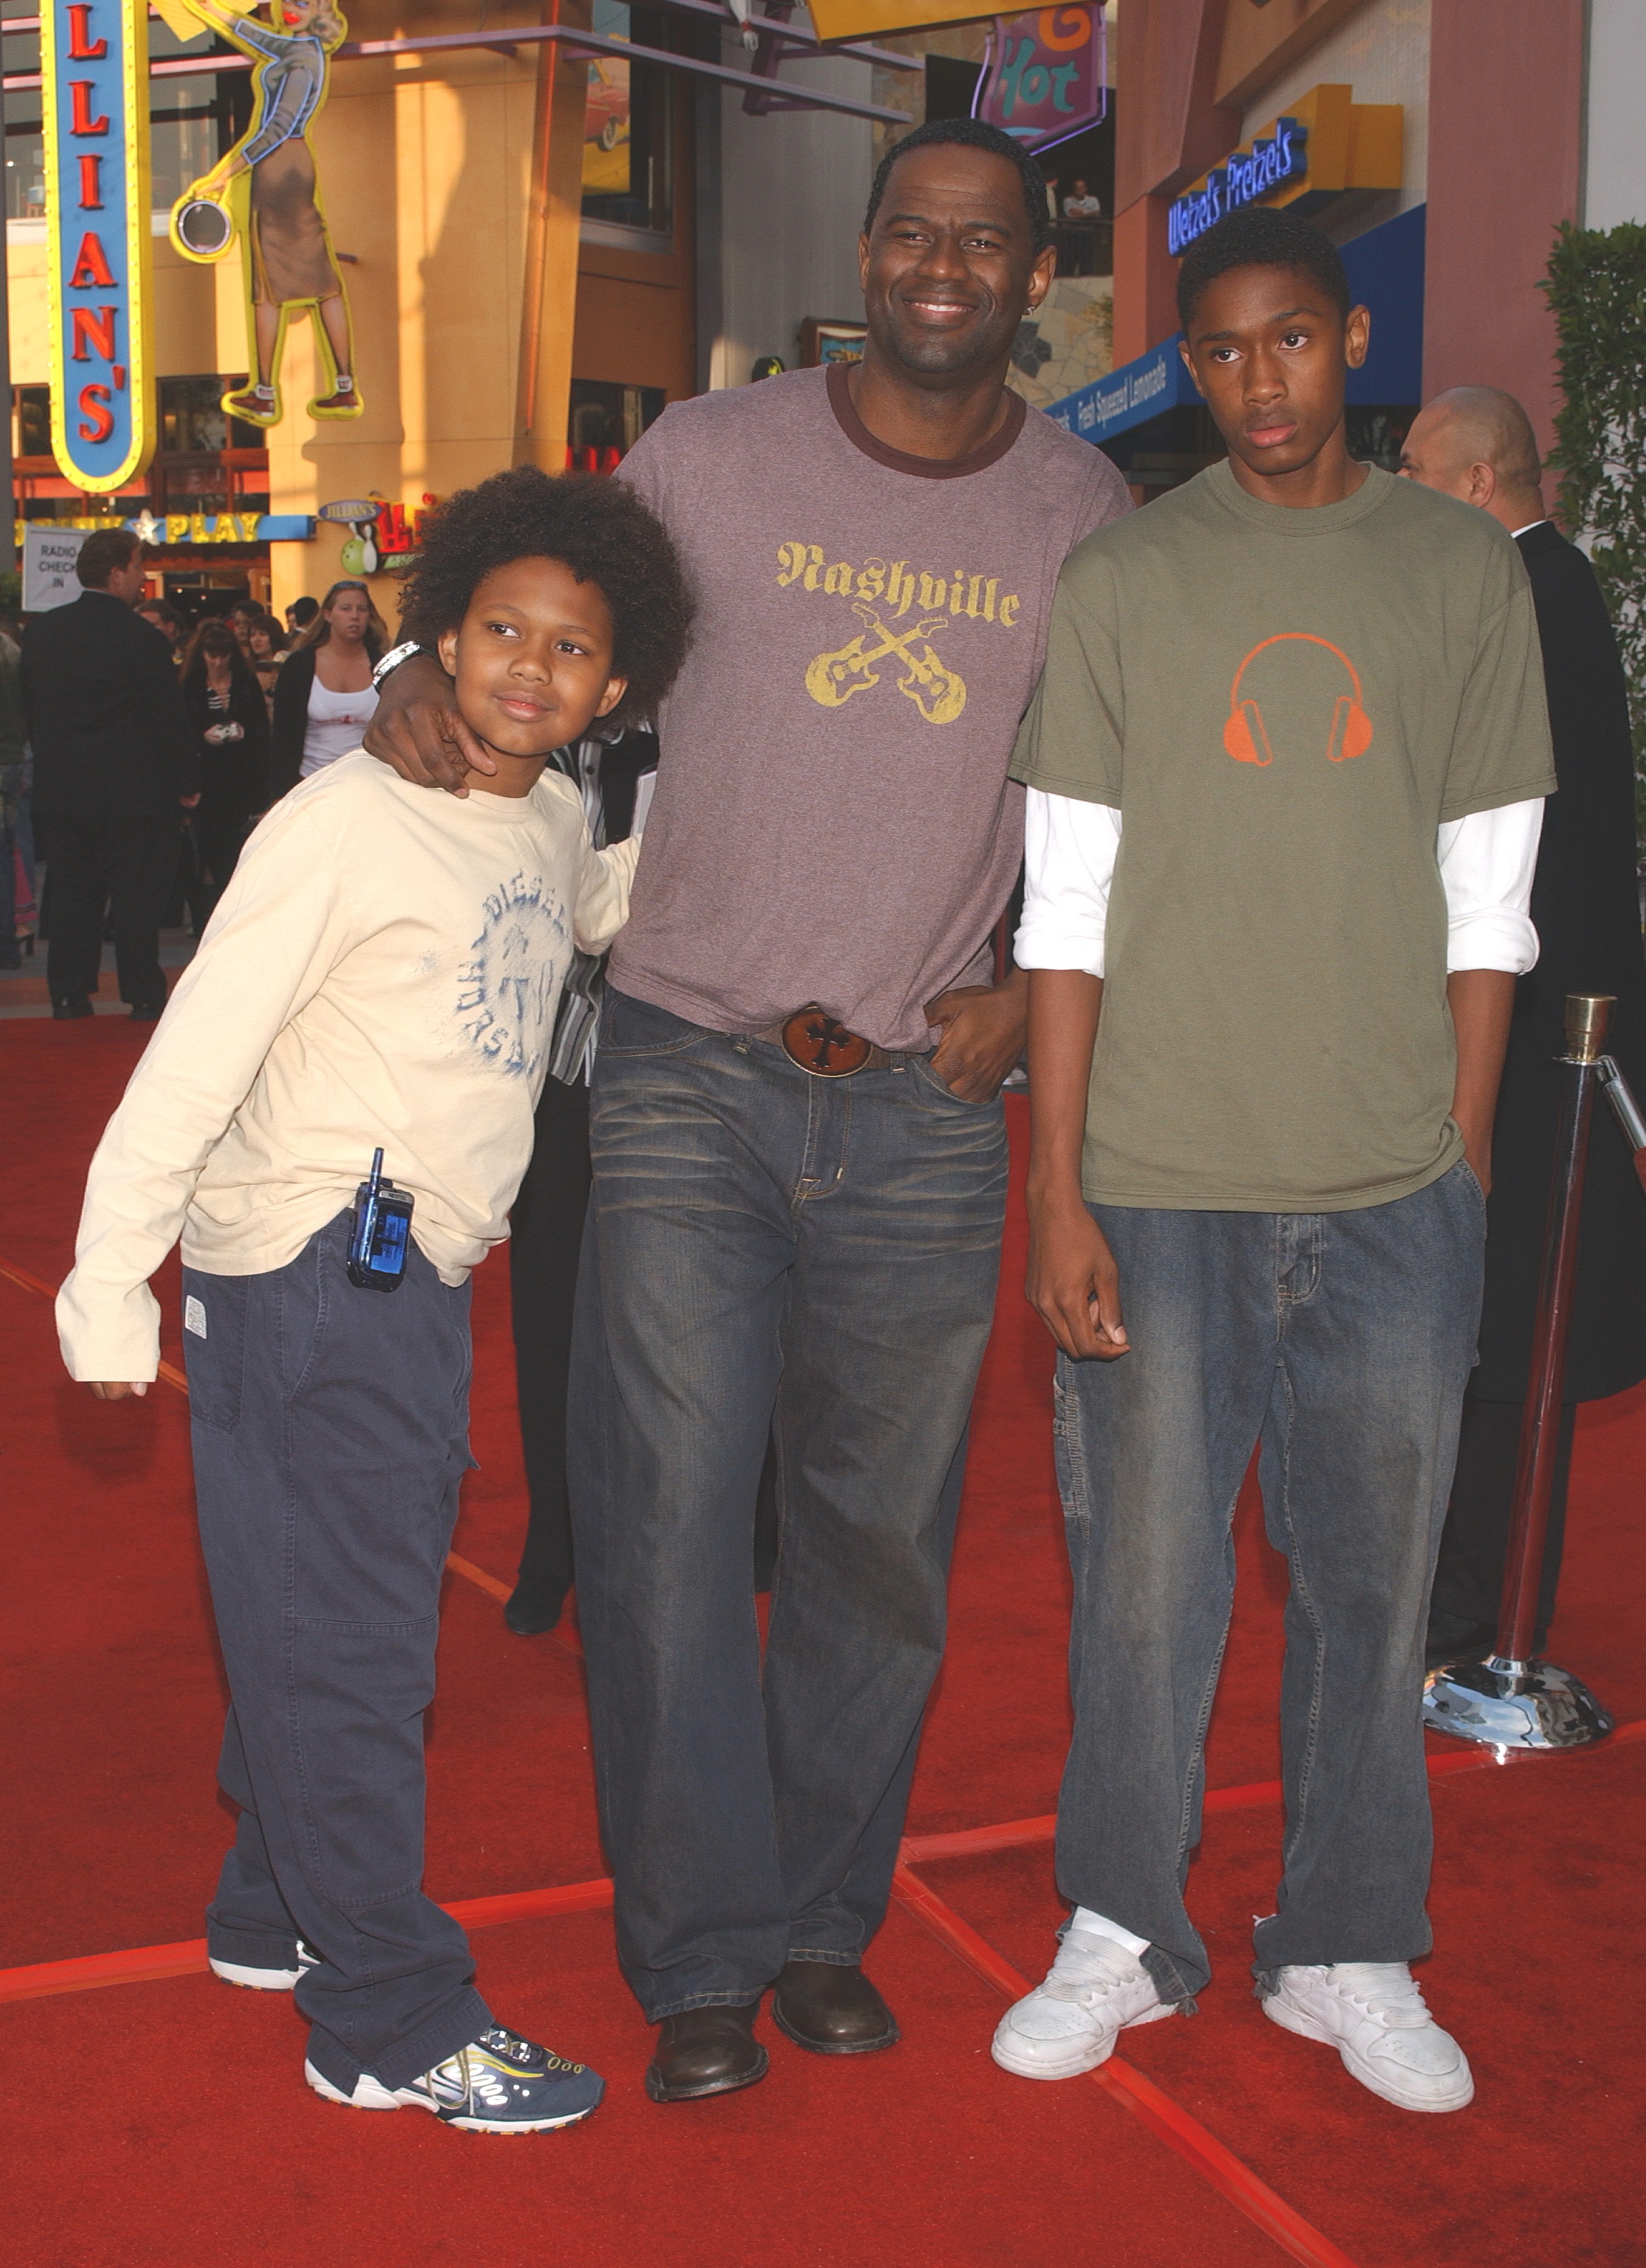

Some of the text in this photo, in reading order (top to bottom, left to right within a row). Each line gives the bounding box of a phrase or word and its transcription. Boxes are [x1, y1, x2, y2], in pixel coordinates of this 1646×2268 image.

[165, 512, 264, 544] PLAY
[41, 545, 77, 557] RADIO
[52, 577, 64, 587] IN
[774, 542, 1020, 627] Nashville
